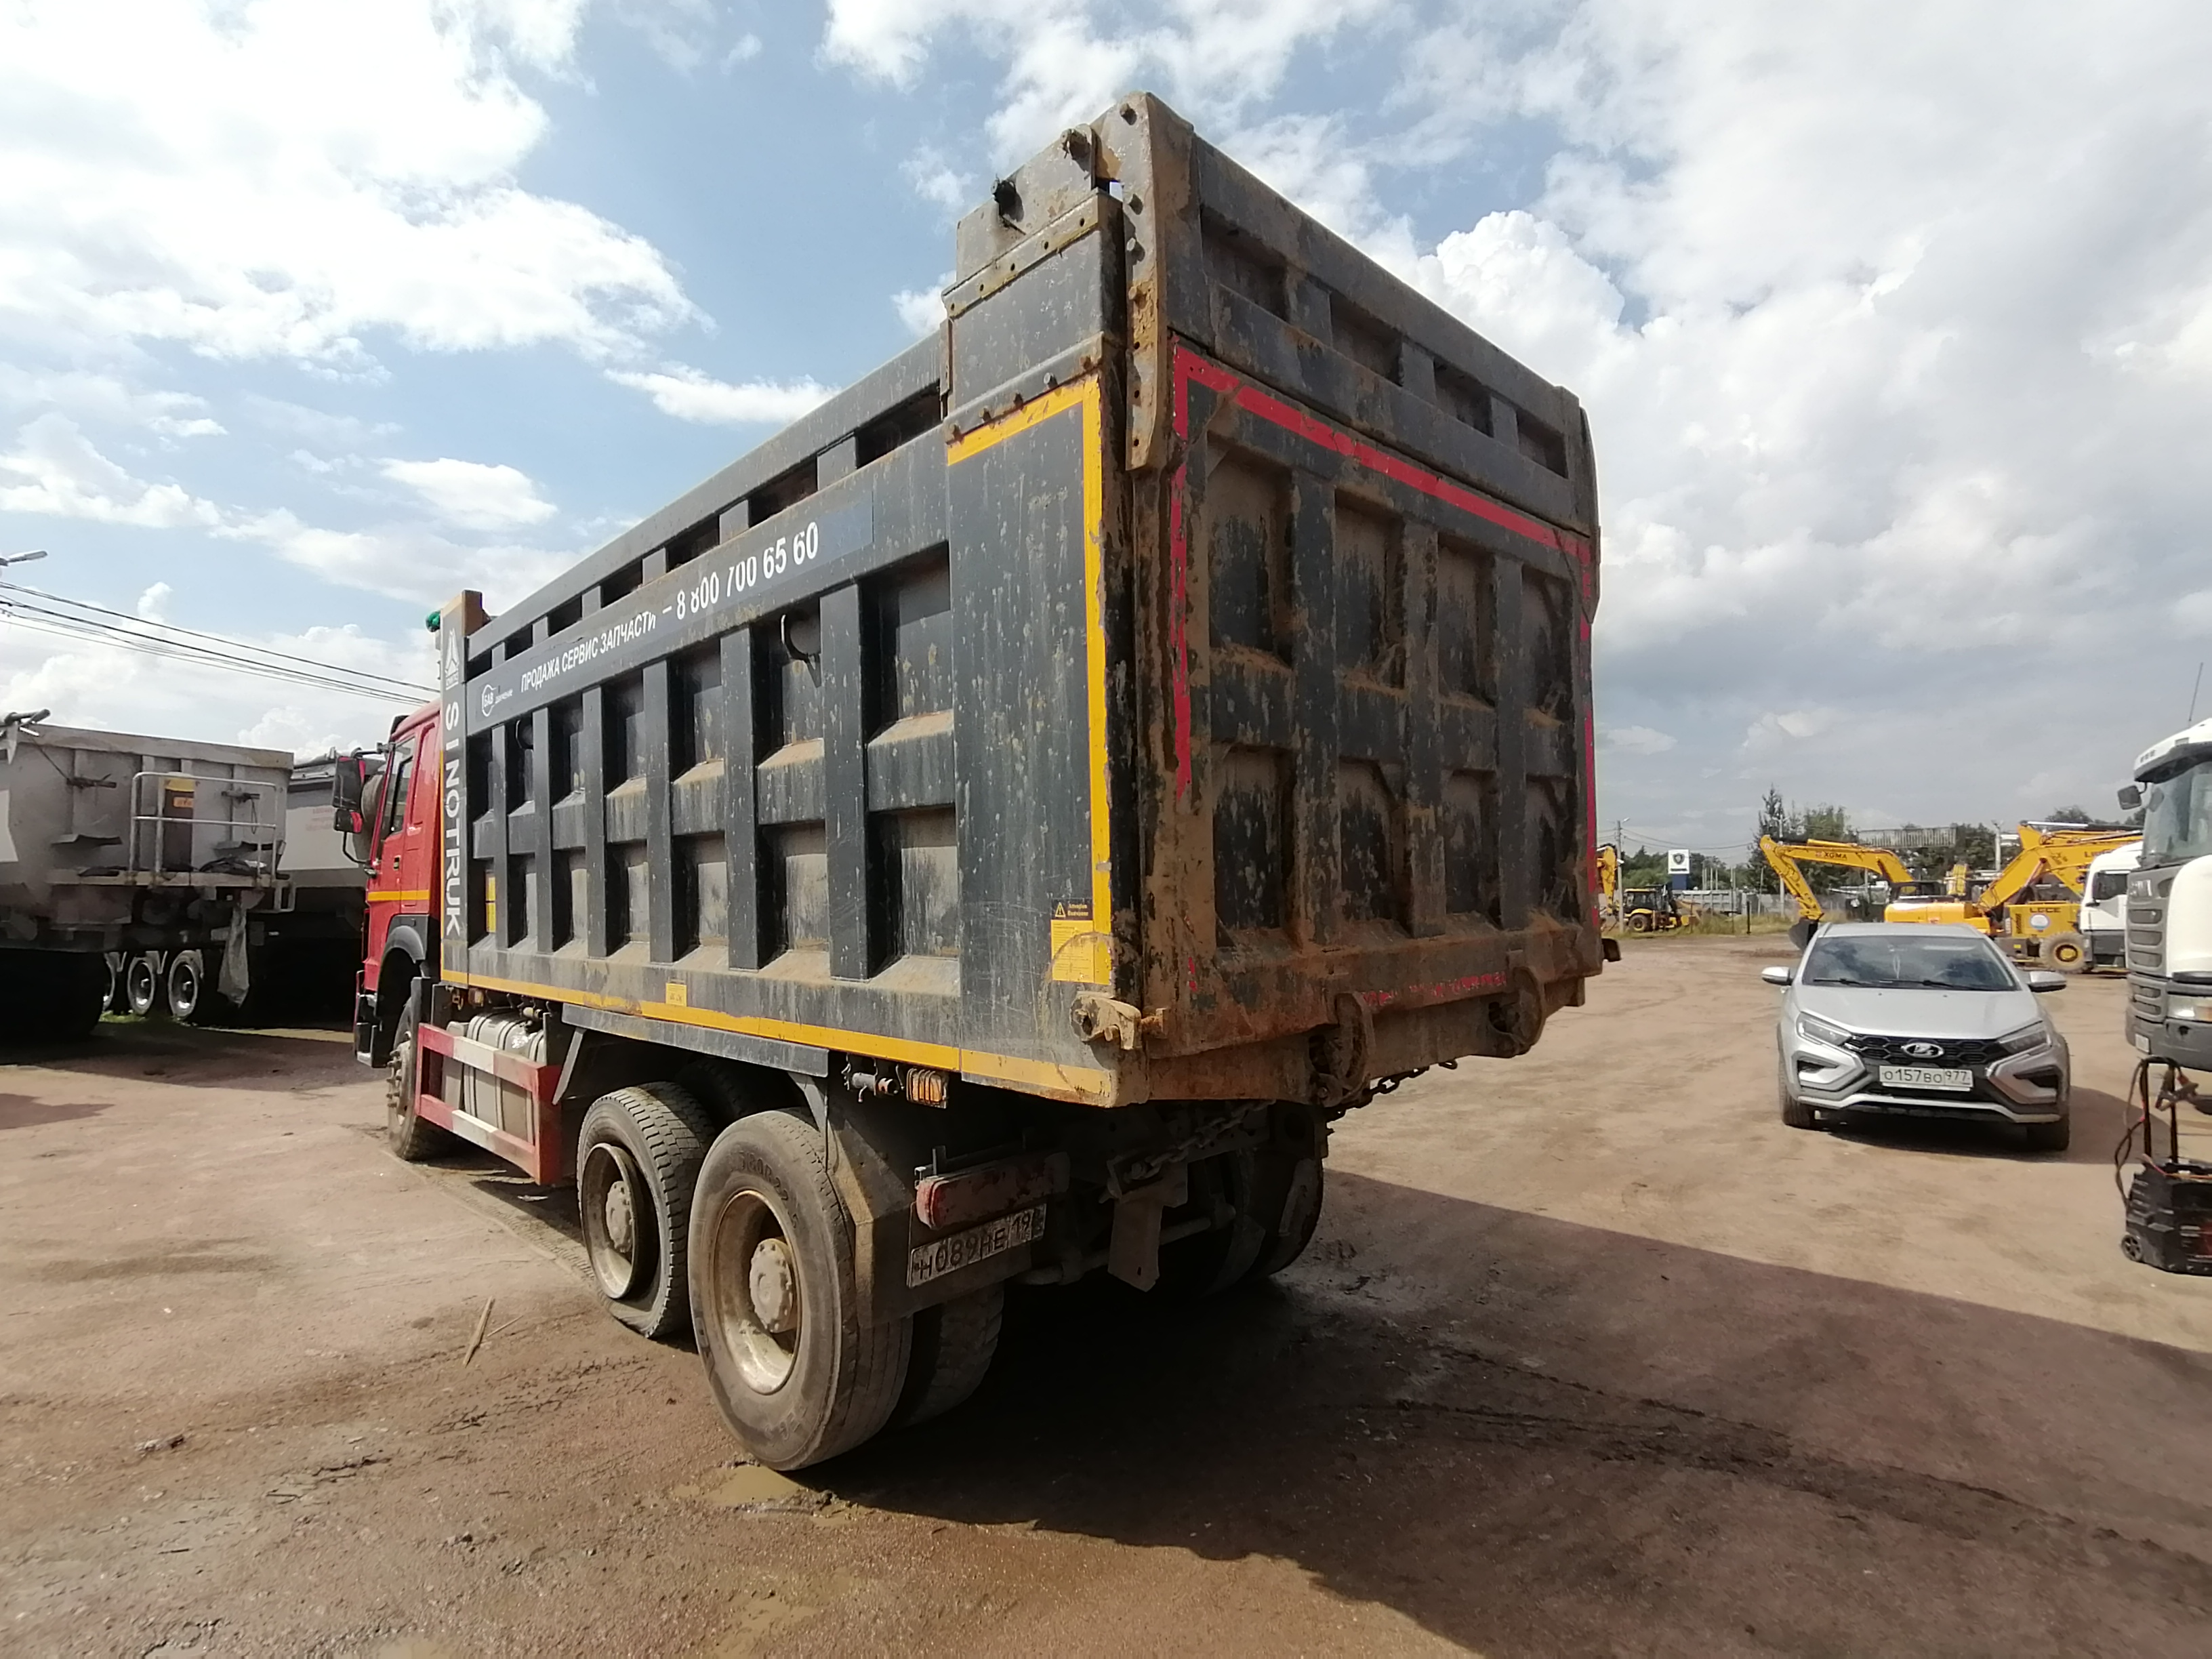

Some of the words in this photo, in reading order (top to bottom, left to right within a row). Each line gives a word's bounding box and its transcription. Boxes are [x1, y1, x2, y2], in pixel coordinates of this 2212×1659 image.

[521, 657, 560, 693] ПРОДАЖА
[562, 637, 598, 672] СЕРВИС
[600, 611, 656, 654] ЗАПЧАСТИ
[677, 589, 686, 619] 8
[691, 572, 719, 613] 800
[726, 556, 757, 597] 700
[763, 537, 786, 579] 65
[793, 522, 818, 565] 60
[445, 701, 461, 937] SINOTRUK
[1945, 1070, 1967, 1081] 977
